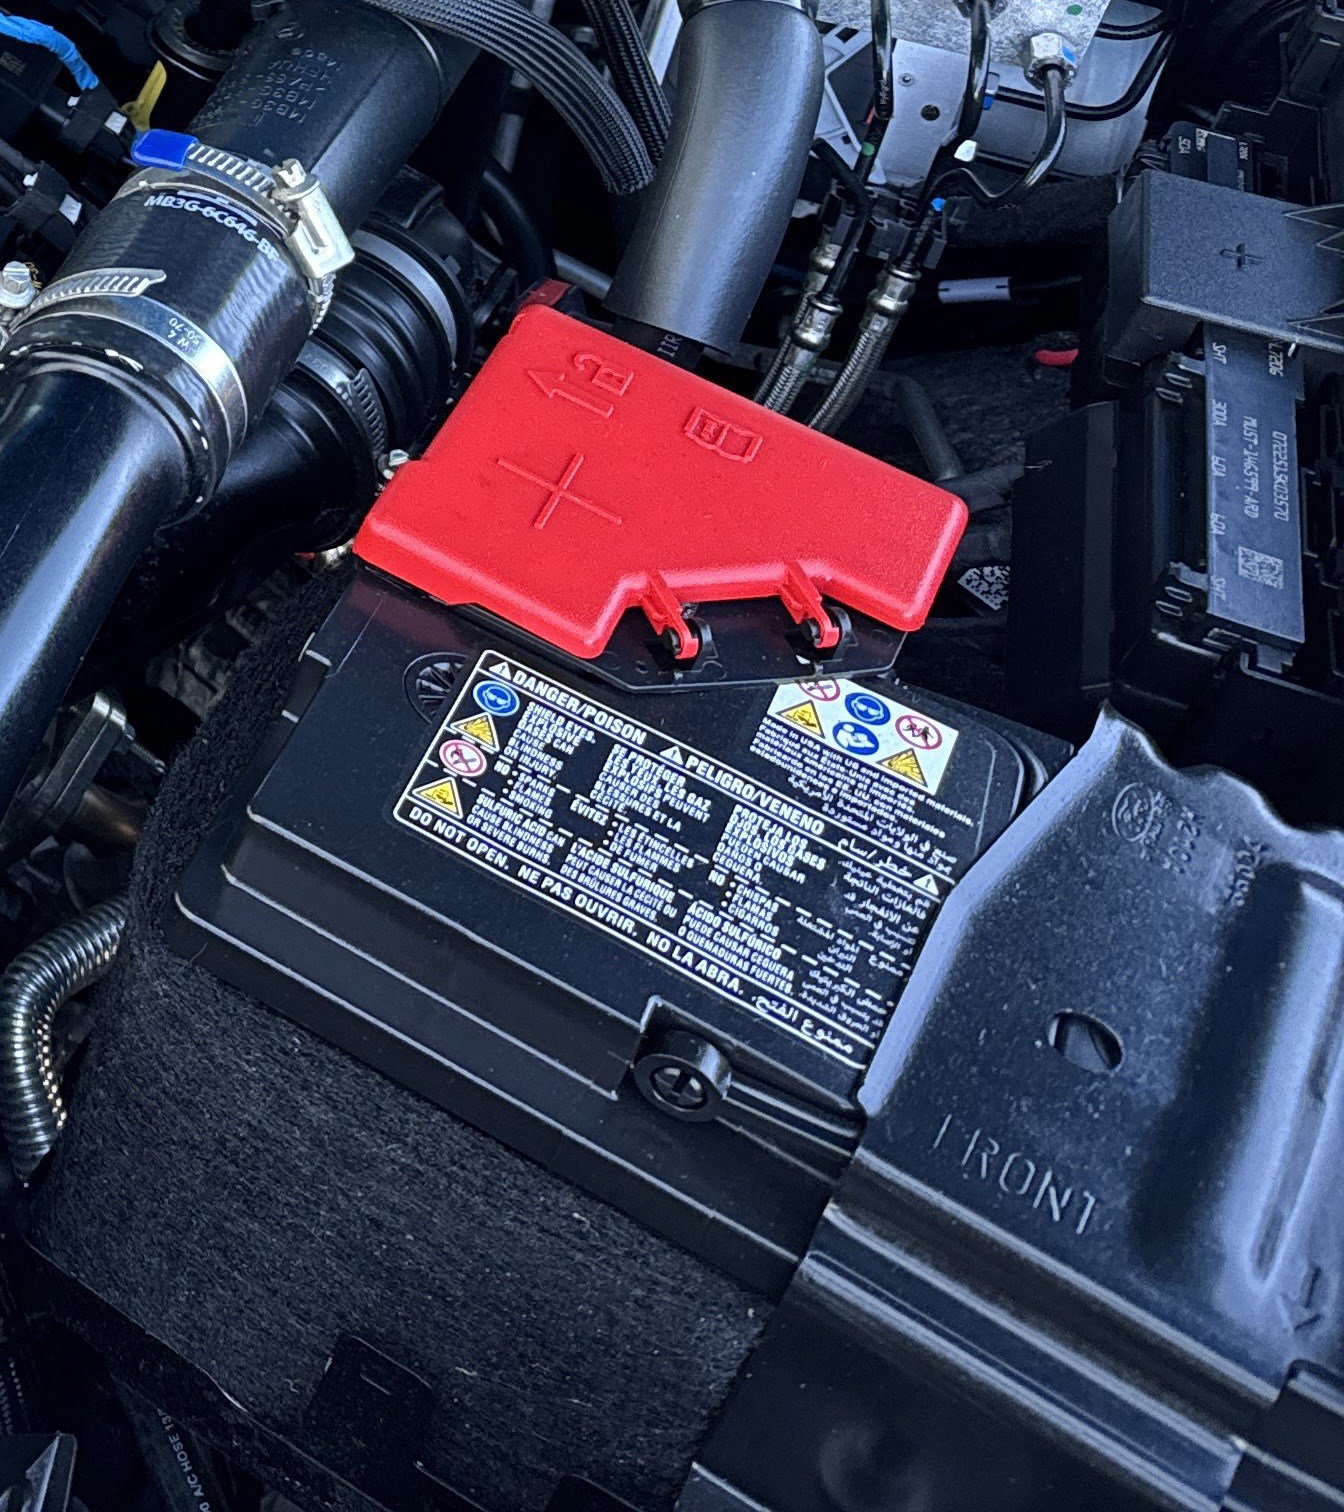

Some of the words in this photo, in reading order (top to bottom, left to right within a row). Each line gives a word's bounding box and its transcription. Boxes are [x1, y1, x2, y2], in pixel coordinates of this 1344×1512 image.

[1212, 400, 1226, 426] 300A
[510, 665, 648, 749] DANGER/POISON
[525, 700, 566, 728] SHIELD
[563, 718, 599, 745] EYES.
[683, 752, 826, 838] PELIGRO/VENENO
[407, 805, 434, 827] DO
[432, 817, 467, 845] NOT
[463, 835, 514, 871] OPEN.
[516, 862, 542, 885] NE
[539, 874, 575, 902] PAS
[572, 891, 642, 937] OUVRIR.
[644, 929, 673, 954] NO
[670, 944, 697, 967] LA
[693, 956, 749, 996] ABRA.
[169, 1433, 192, 1472] HOSE
